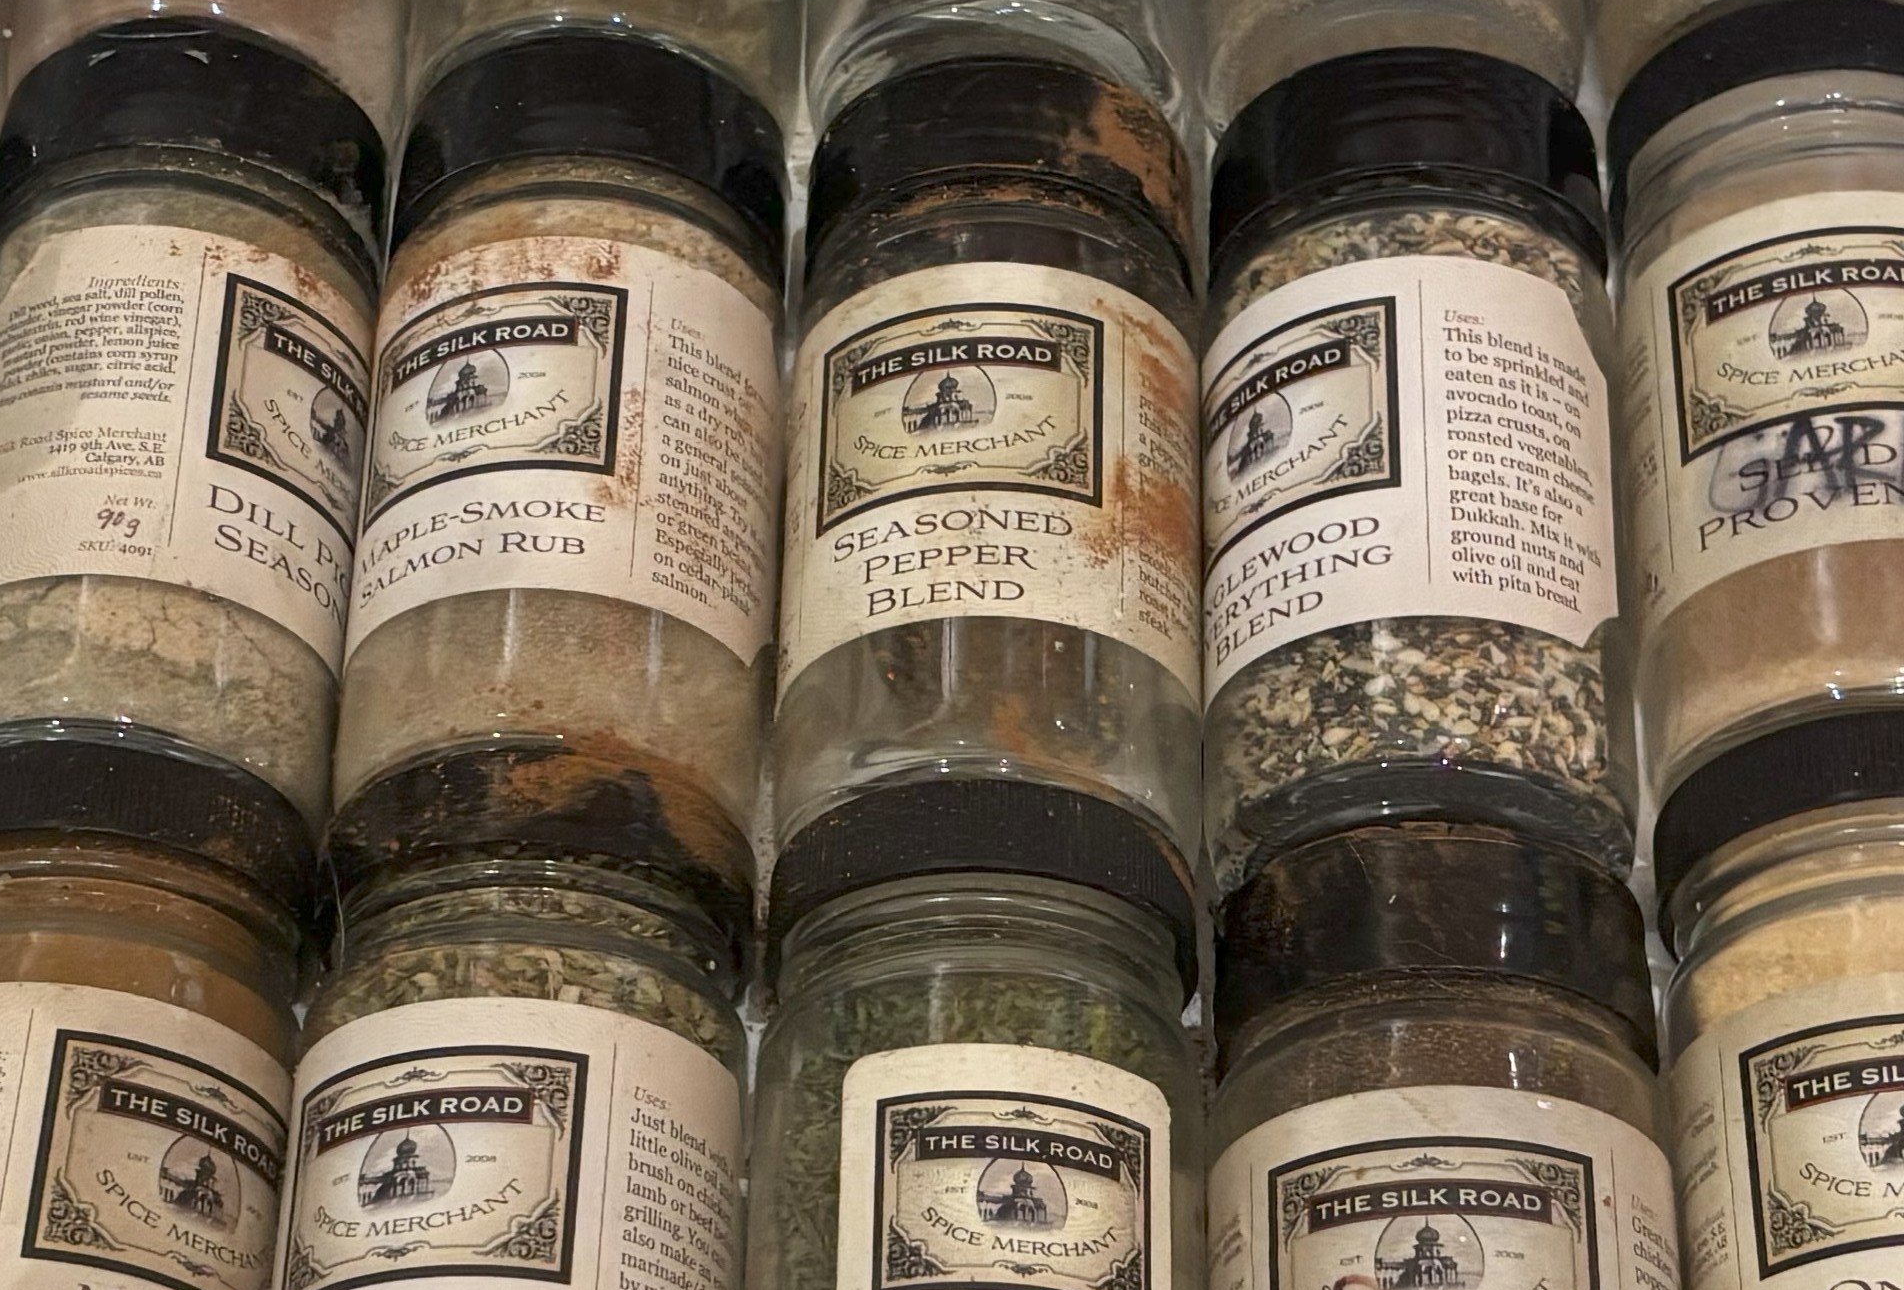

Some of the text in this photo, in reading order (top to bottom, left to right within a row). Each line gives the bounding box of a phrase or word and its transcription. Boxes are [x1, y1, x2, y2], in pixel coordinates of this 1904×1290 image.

[1445, 388, 1517, 410] avocado
[1446, 409, 1493, 426] pizza
[1450, 506, 1525, 531] Dukkah.
[360, 501, 608, 574] MAPLE-SMOKE
[498, 530, 587, 556] RUB
[833, 509, 1073, 564] SEASONED
[1450, 528, 1516, 551] ground
[862, 545, 1037, 585] PEPPER
[1452, 548, 1522, 572] olive oil
[1452, 570, 1531, 594] with pita
[868, 579, 1026, 618] BLEND
[1792, 1071, 1852, 1100] THE
[1799, 1161, 1873, 1199] SPICE
